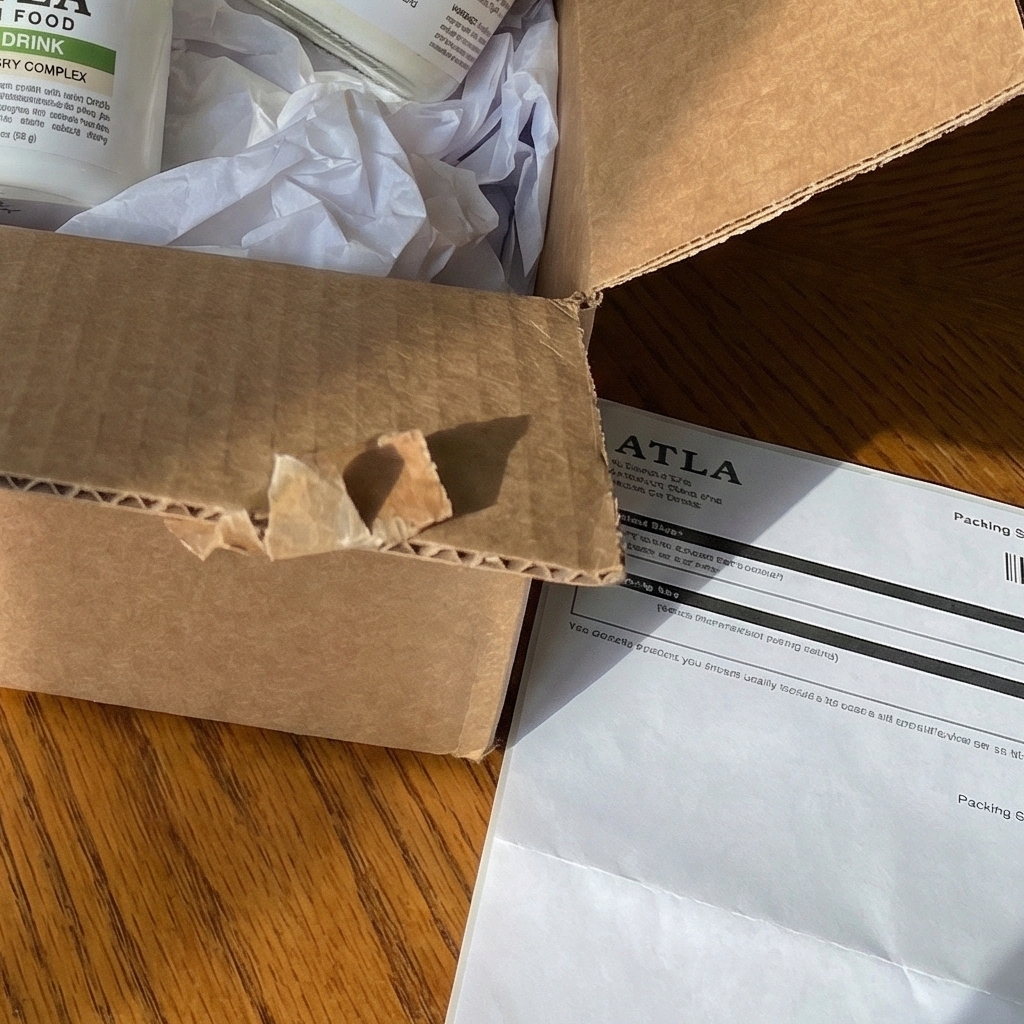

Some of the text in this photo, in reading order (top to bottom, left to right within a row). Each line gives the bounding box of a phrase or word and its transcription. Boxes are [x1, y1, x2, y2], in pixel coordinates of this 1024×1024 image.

[13, 9, 75, 31] FOOD
[1, 31, 65, 56] DRINK
[24, 61, 87, 84] COMPLEX
[614, 435, 742, 486] ATLA
[954, 511, 1011, 537] Packing
[958, 794, 1011, 820] Packing
